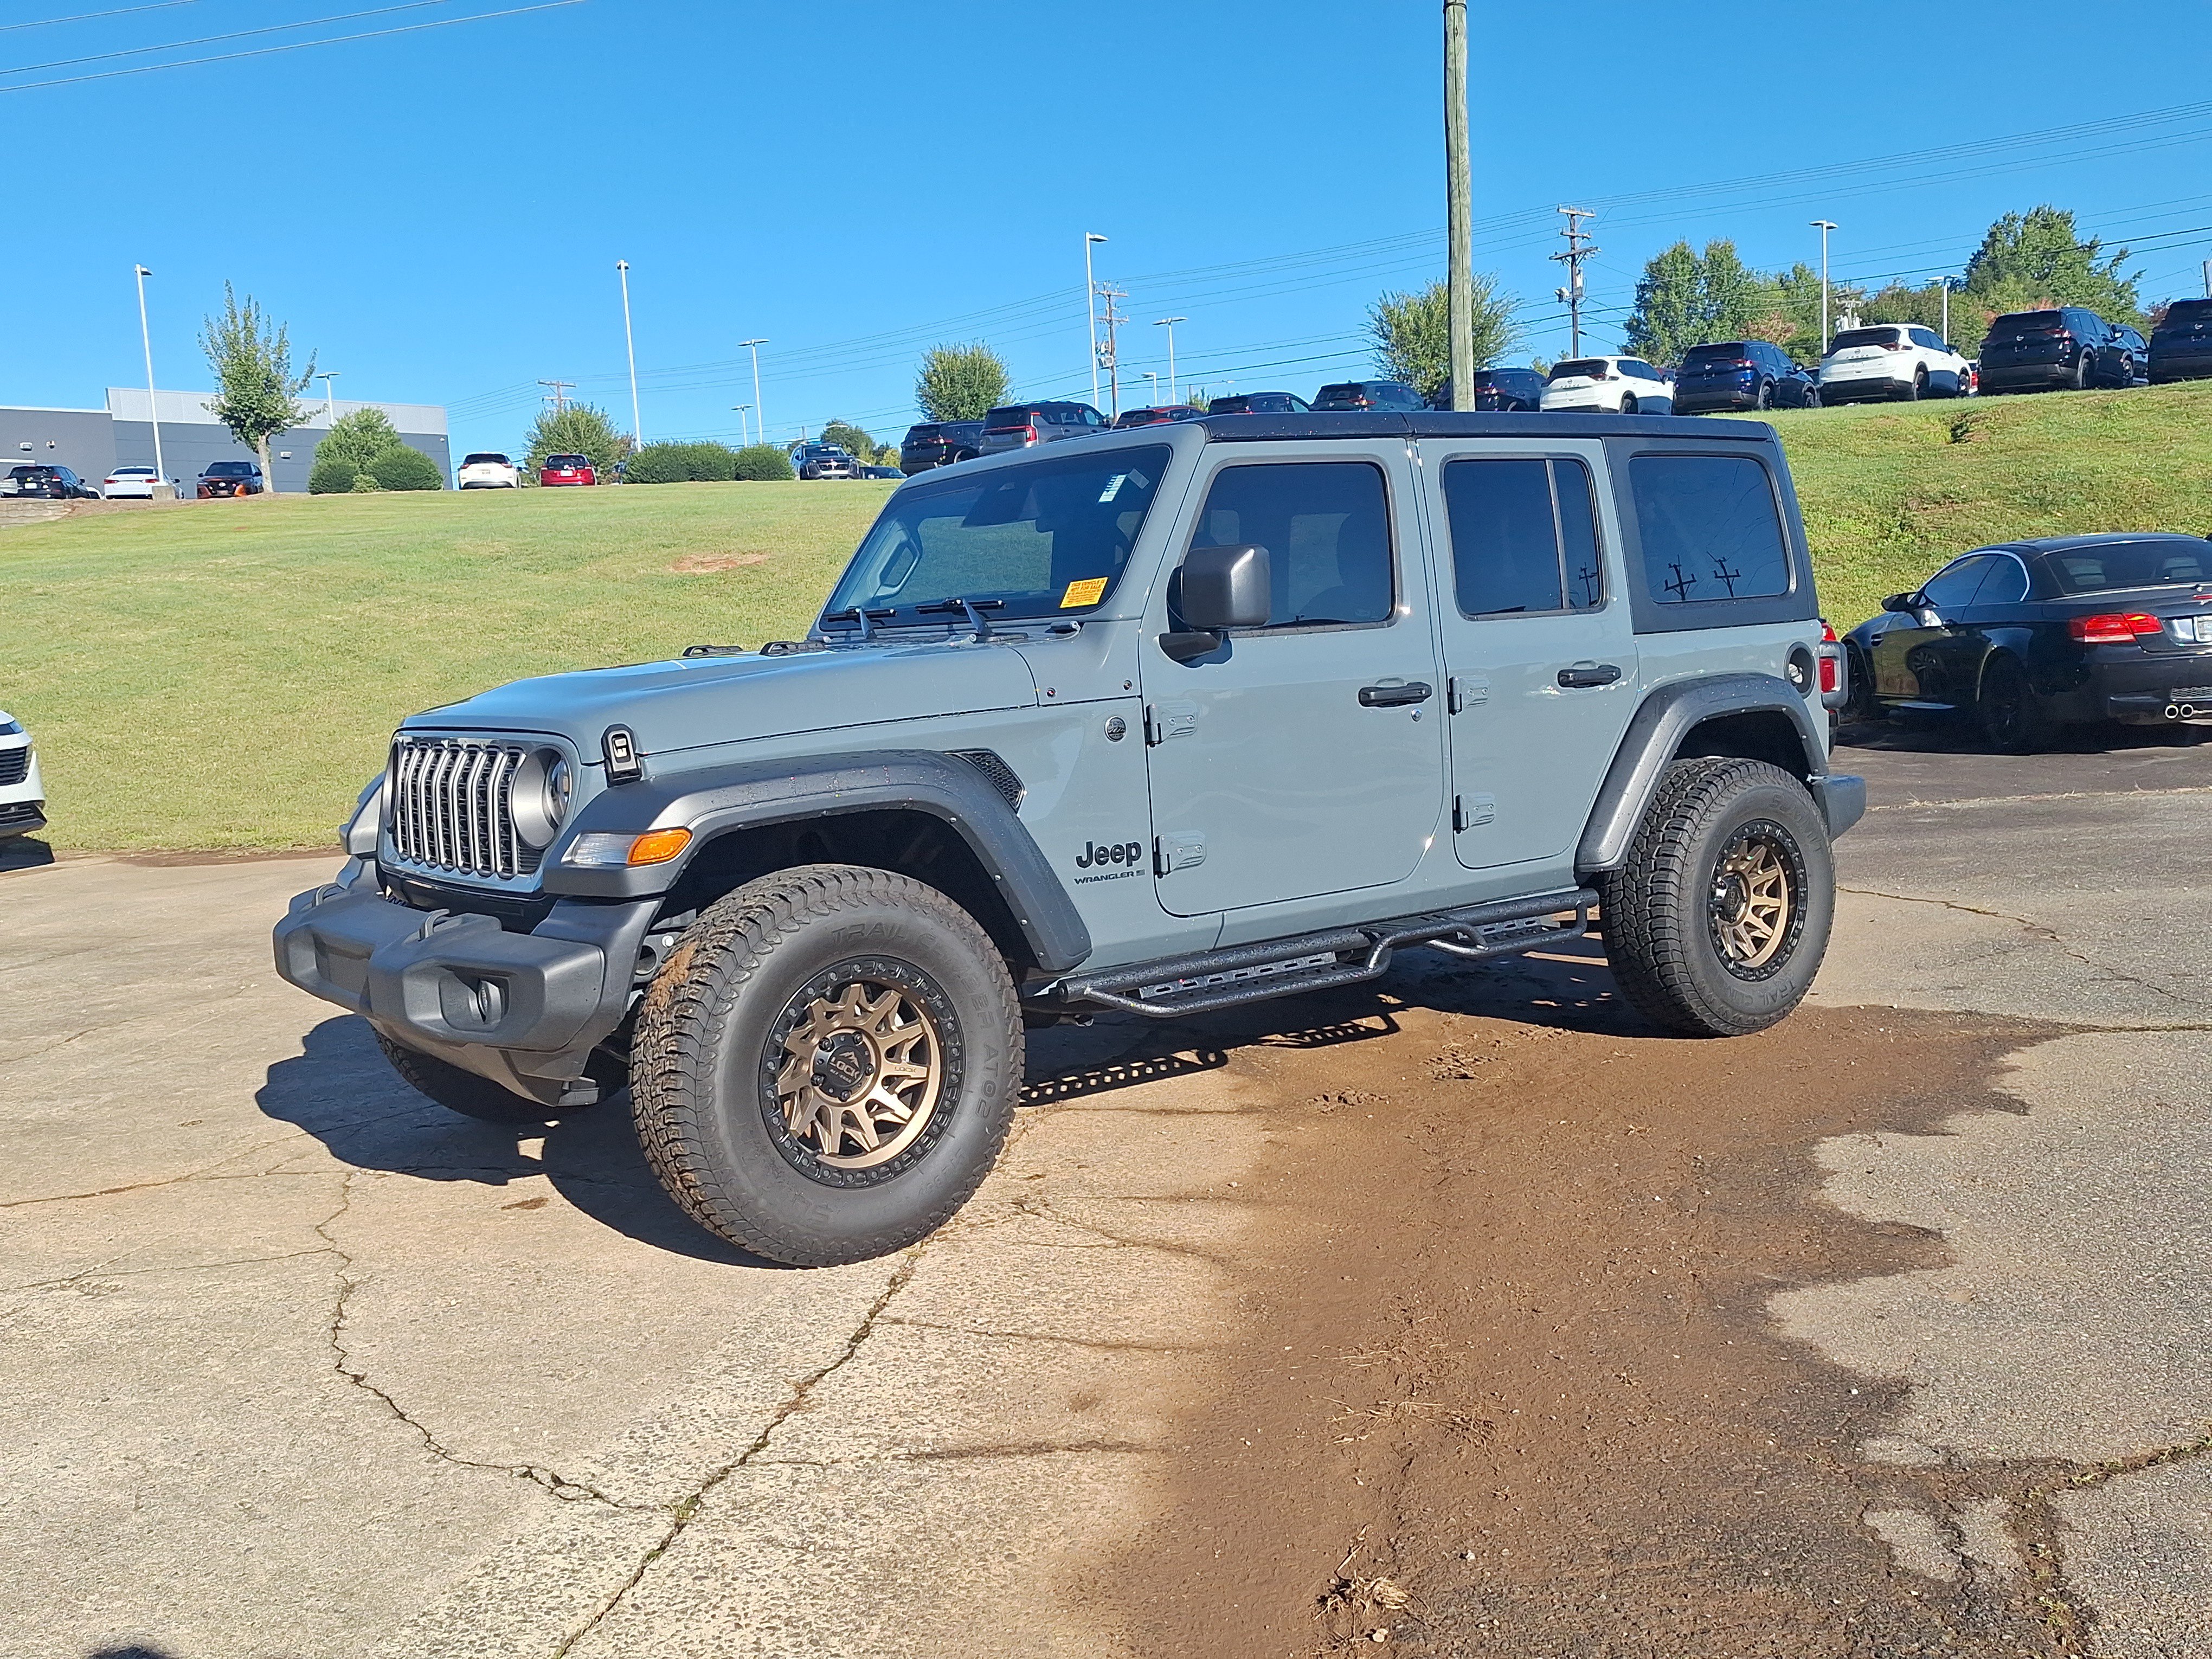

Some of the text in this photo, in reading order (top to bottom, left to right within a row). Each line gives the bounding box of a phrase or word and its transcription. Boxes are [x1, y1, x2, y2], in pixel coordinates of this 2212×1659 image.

[1076, 841, 1142, 868] Jeep
[1074, 871, 1134, 885] WRANGLER
[831, 922, 905, 944] TRAIL
[975, 1044, 999, 1118] AT02
[829, 1057, 860, 1079] LOCK
